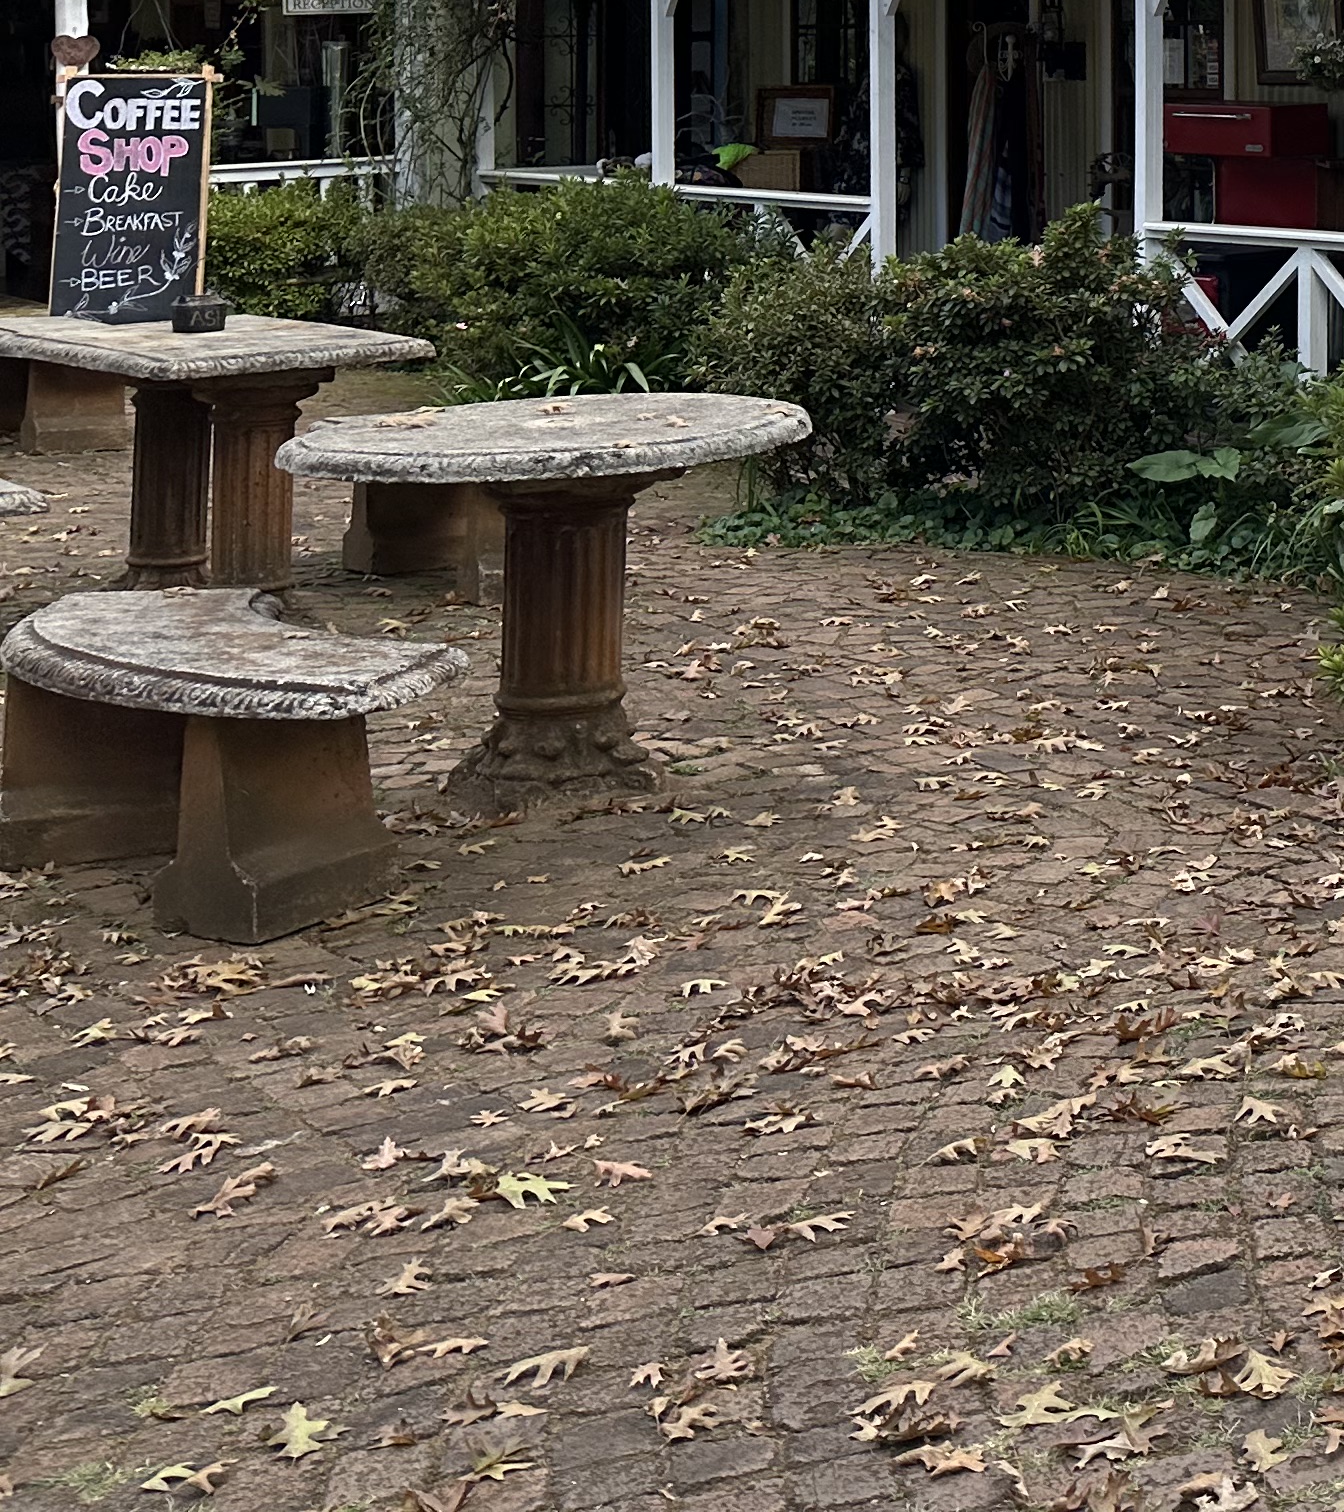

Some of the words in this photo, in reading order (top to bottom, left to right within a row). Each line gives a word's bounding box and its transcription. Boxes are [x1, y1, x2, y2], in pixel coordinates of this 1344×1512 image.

[65, 80, 200, 131] COFFEE
[77, 129, 189, 176] SHOP
[87, 172, 164, 206] Cake
[80, 207, 184, 237] BREAKFAST
[80, 236, 150, 268] Wine
[80, 265, 162, 292] BEER
